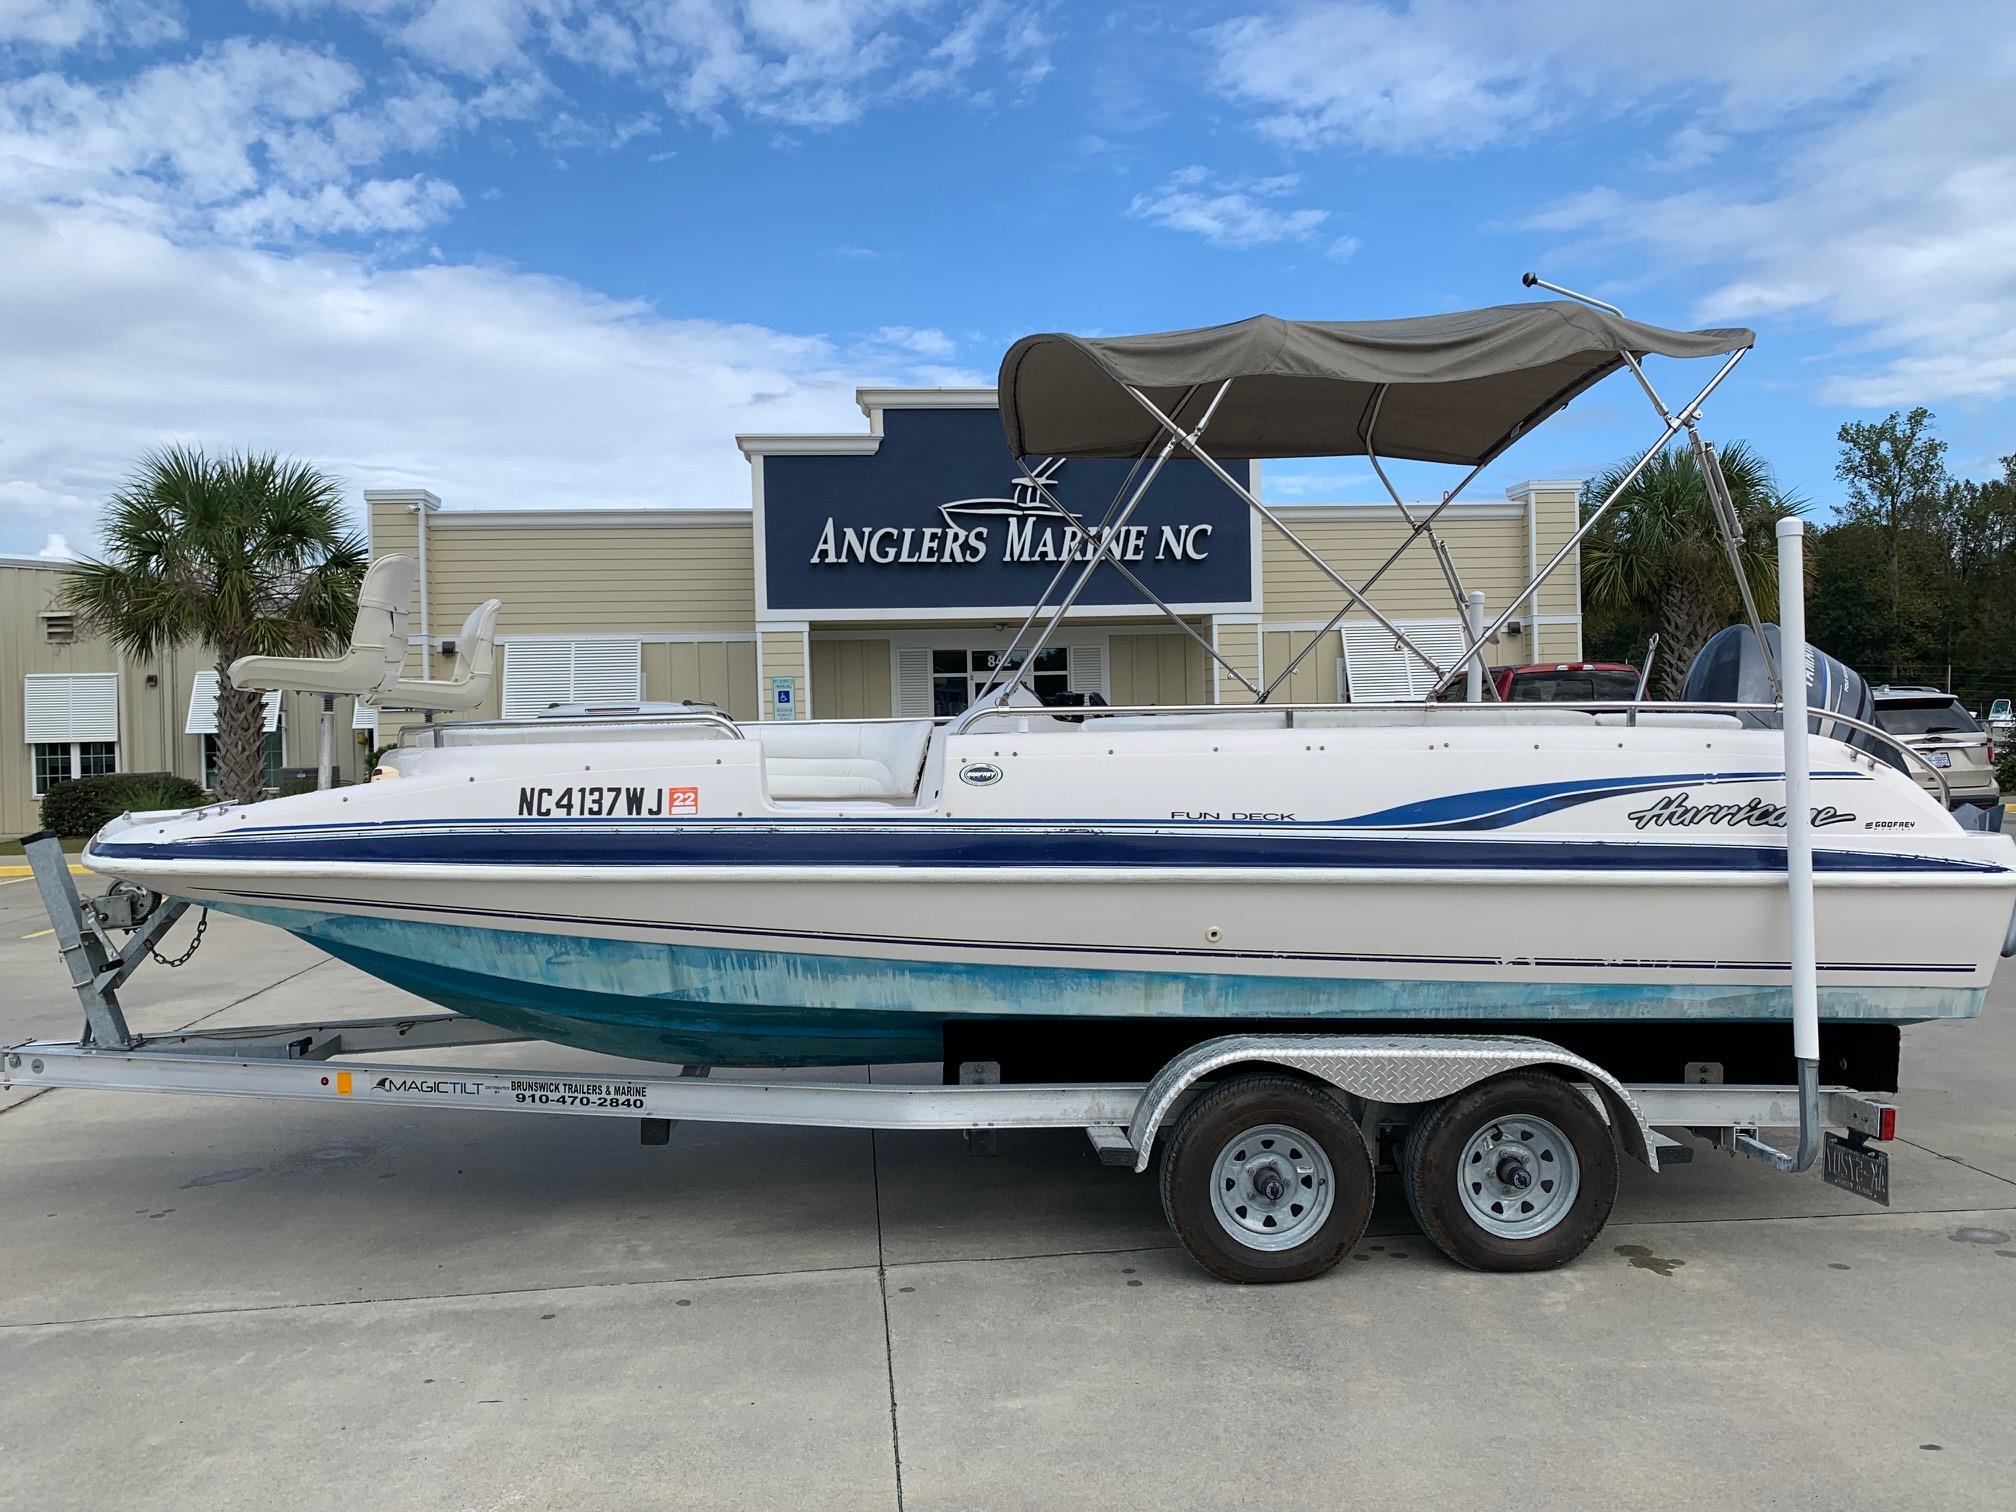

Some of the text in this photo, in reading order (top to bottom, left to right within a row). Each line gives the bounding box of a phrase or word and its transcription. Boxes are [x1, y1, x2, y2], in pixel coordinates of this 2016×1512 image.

[810, 517, 1213, 564] ANGLERS MARINE NC
[673, 792, 696, 806] 22
[1171, 811, 1296, 821] FUN DECK
[389, 1080, 484, 1095] MAGICTILT
[511, 1081, 647, 1097] BRUNSWICK TRAILERS & MARINE
[515, 1093, 644, 1109] 910-470-2840
